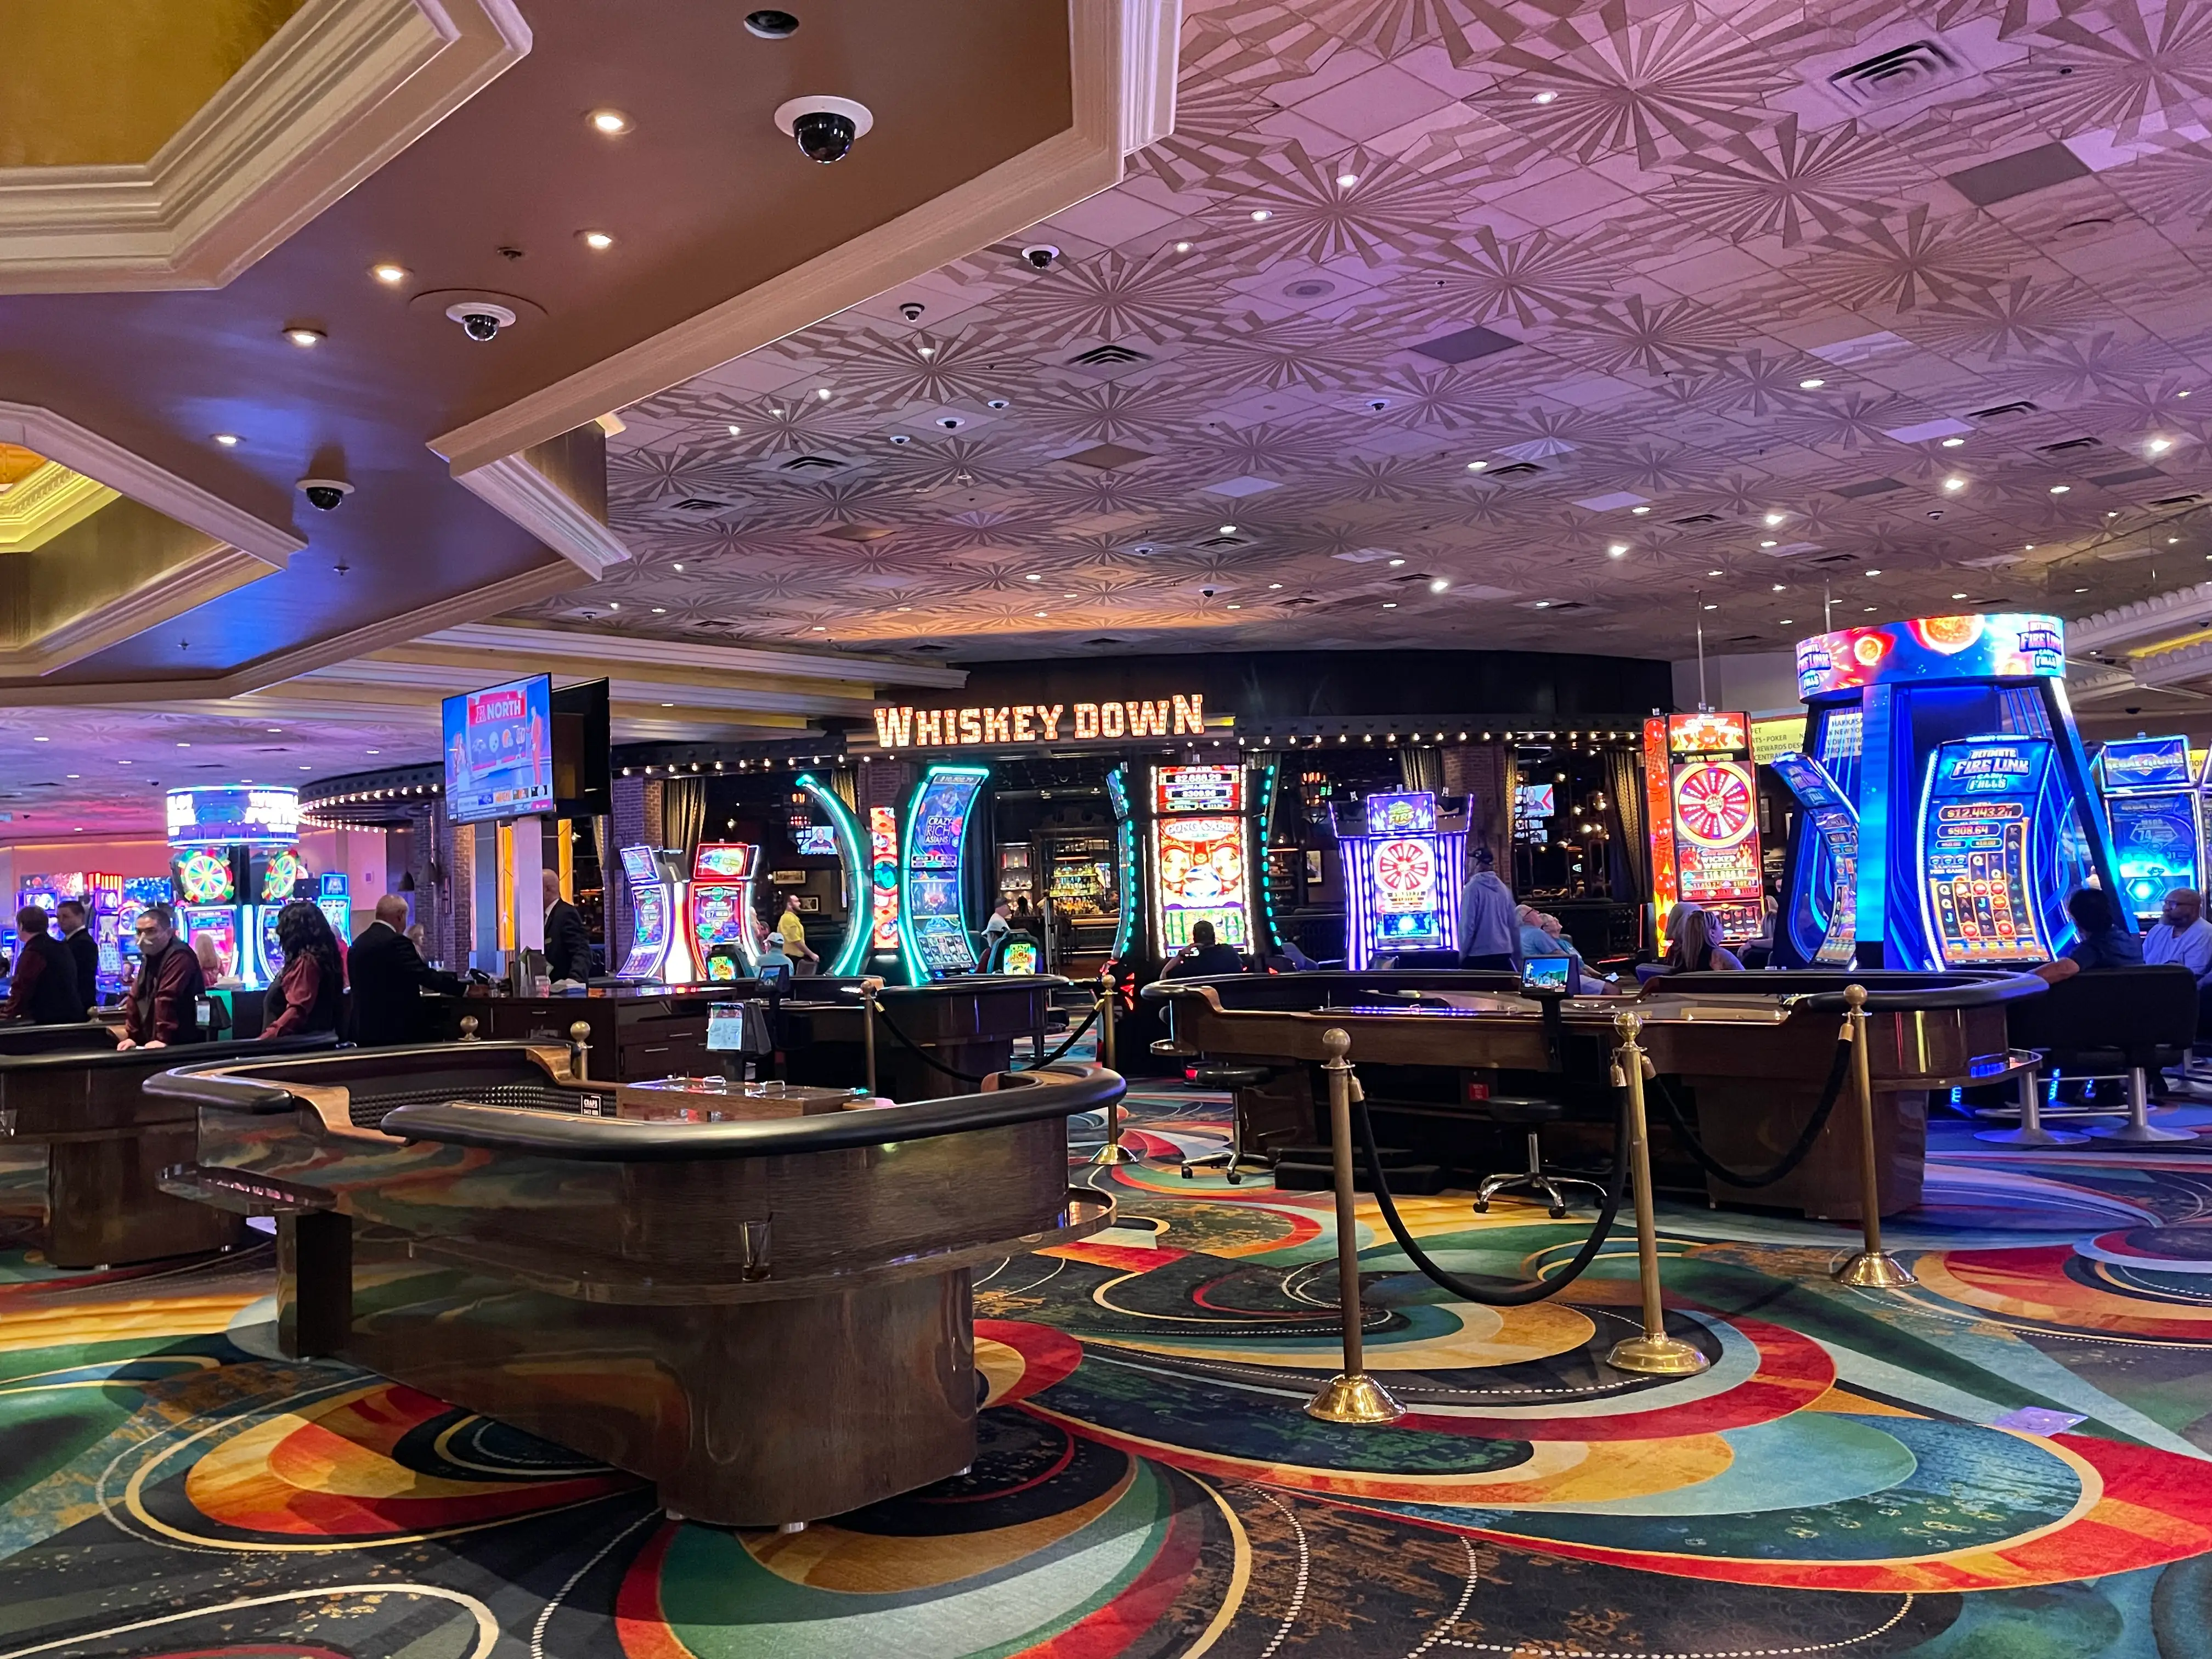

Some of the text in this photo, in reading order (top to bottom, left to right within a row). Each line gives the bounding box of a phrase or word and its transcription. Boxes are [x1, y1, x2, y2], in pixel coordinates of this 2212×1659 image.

[2020, 633, 2046, 650] FIRE
[487, 698, 521, 720] NORTH
[874, 693, 1205, 748] WHISKEY DOWN
[1756, 743, 1787, 752] REWARDS
[1970, 749, 2017, 759] ULTIMATE
[1952, 757, 2029, 776] FIRE LINK
[1969, 778, 2006, 790] FALLS
[928, 817, 952, 826] CRAZY
[926, 825, 951, 837] RICH
[1700, 855, 1736, 864] WICKED
[1703, 862, 1735, 871] WHEEL
[584, 1099, 597, 1107] CRAPS
